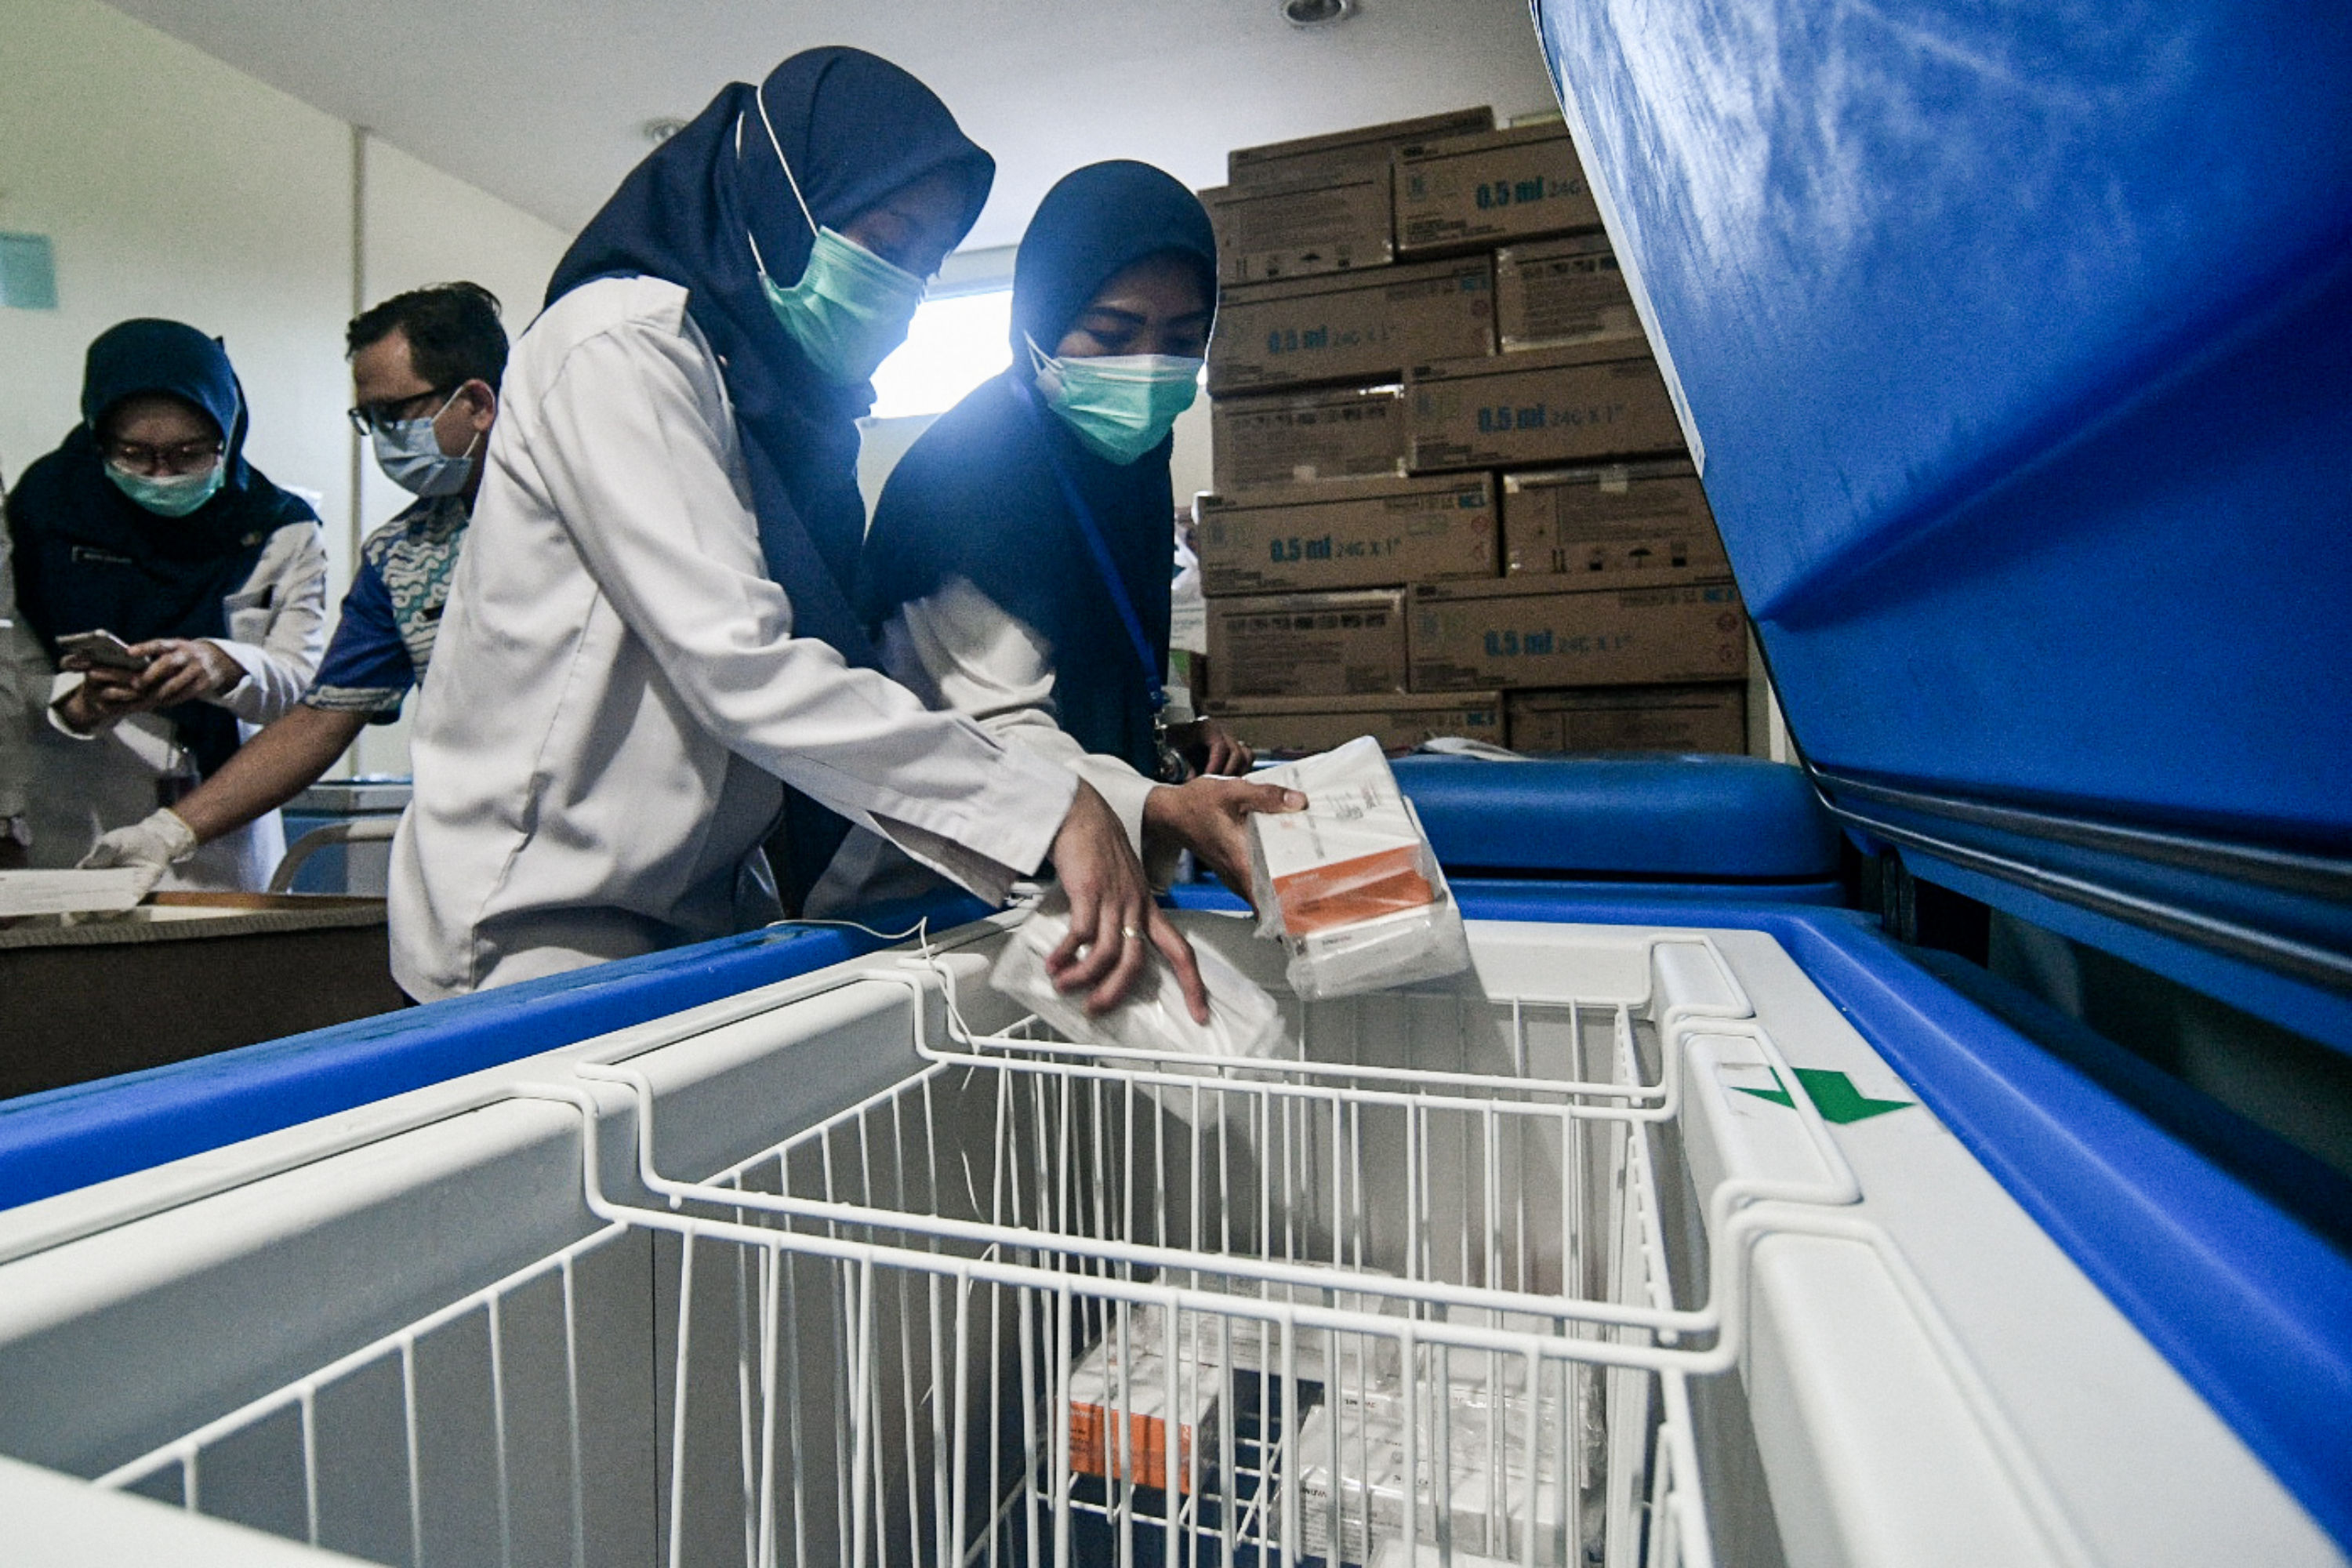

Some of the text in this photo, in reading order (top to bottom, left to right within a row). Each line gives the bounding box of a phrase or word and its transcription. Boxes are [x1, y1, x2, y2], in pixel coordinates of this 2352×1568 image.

[1476, 180, 1510, 210] 0.5
[1514, 175, 1544, 204] ml
[1302, 324, 1328, 350] ml
[1479, 406, 1512, 434] 0.5
[1517, 403, 1546, 430] ml
[1270, 537, 1301, 563] 0.5
[1305, 533, 1331, 560] ml
[1523, 628, 1553, 655] ml
